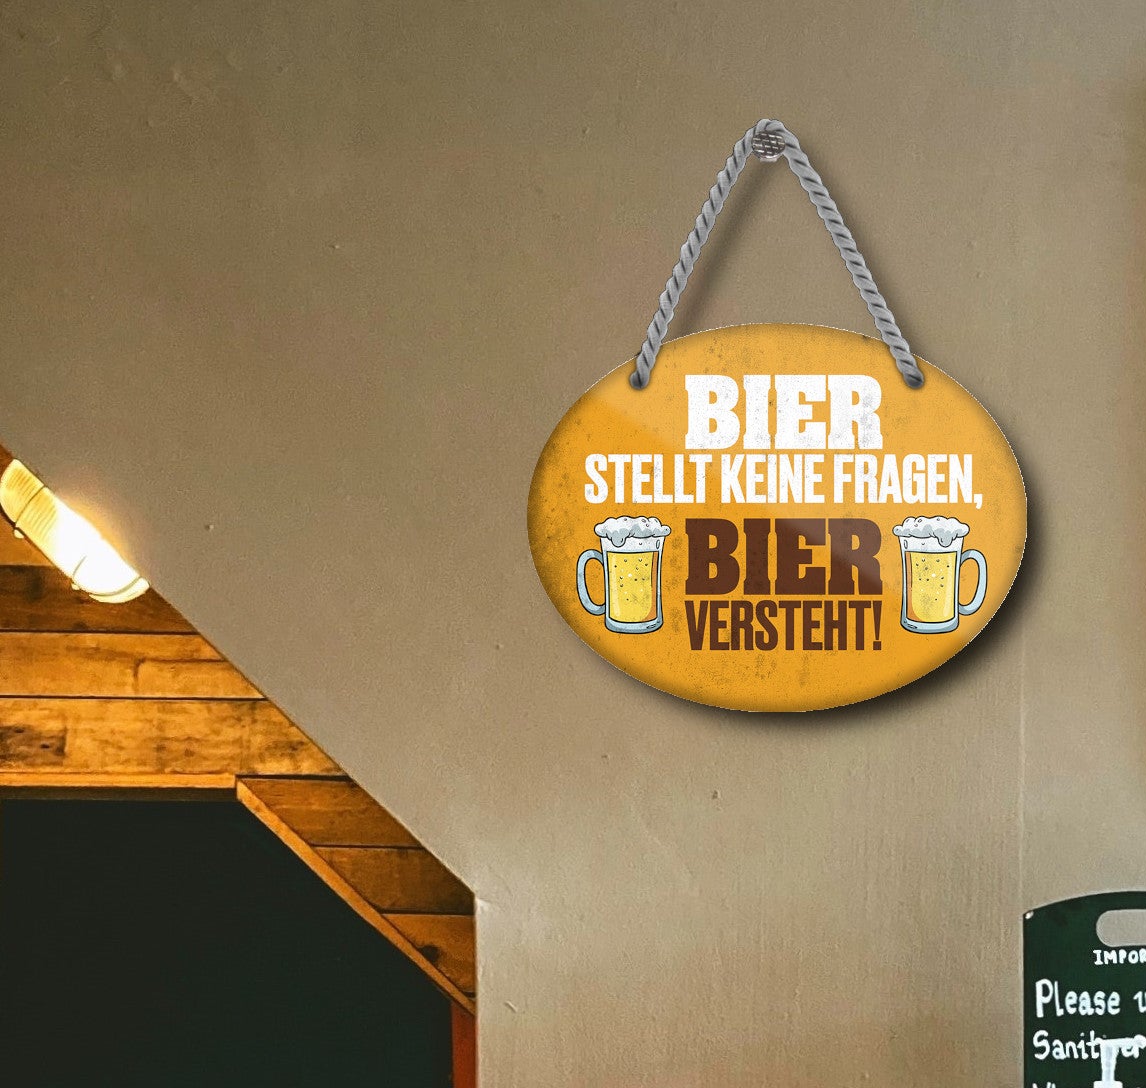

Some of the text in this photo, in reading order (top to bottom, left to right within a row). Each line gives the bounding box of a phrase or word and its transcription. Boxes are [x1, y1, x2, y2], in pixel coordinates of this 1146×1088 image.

[684, 374, 883, 450] BIER
[584, 453, 984, 510] STELLT KEINE FRAGEN,
[684, 518, 883, 596] BIER
[684, 600, 883, 652] VERSTEHT!
[1035, 978, 1121, 1018] Please
